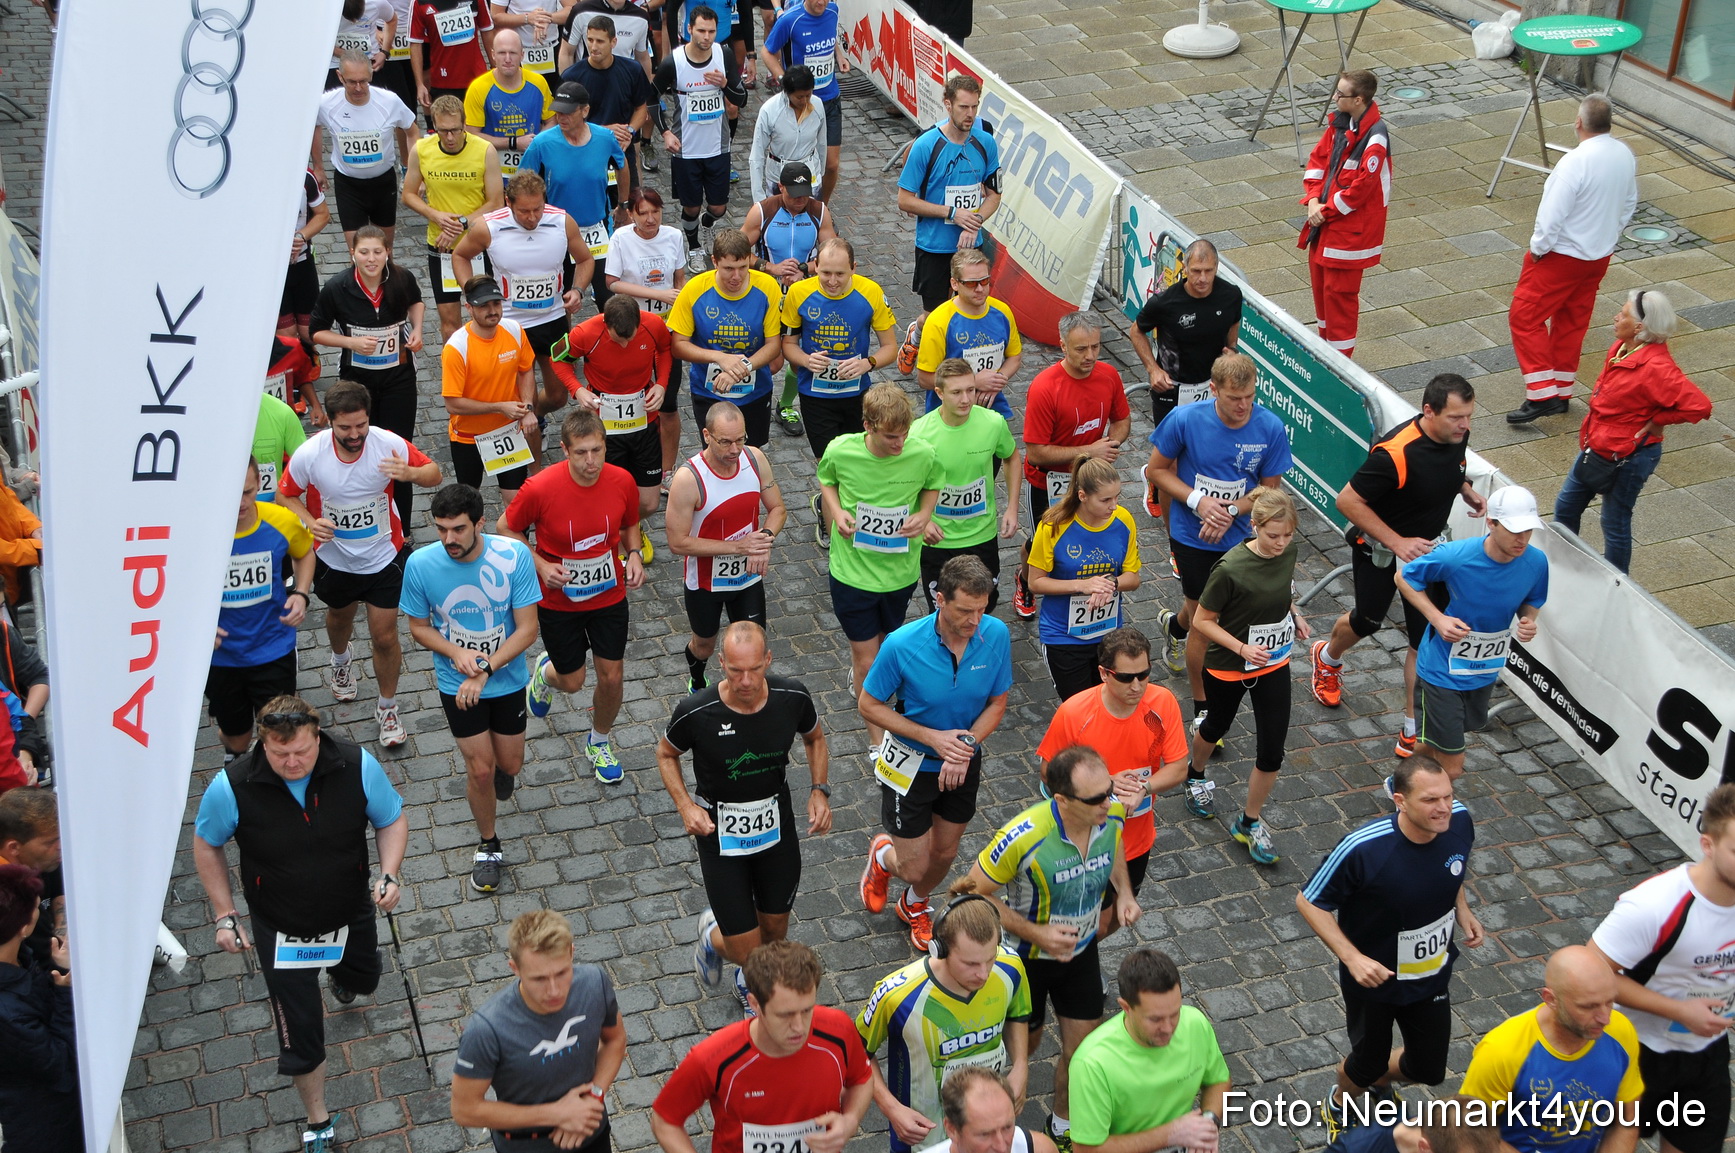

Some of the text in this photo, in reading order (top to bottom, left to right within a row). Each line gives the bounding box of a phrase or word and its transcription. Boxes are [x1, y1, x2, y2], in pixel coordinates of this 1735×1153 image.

[441, 16, 472, 34] 2243
[338, 39, 369, 52] 2823
[450, 33, 469, 41] Thomas
[805, 37, 836, 53] SYSCAD
[528, 49, 549, 63] 639
[809, 60, 833, 77] 2681
[691, 96, 720, 112] 2080
[343, 139, 379, 155] 2946
[504, 152, 523, 166] 26
[954, 194, 977, 209] 652
[516, 282, 553, 299] 2525
[1241, 316, 1313, 384] Event-Leit-Systeme
[977, 355, 994, 372] 36
[132, 281, 205, 482] BKK
[615, 403, 635, 418] 14
[493, 436, 515, 456] 50
[502, 456, 516, 465] Tim
[941, 488, 982, 507] 2708
[1308, 484, 1329, 509] 6352
[329, 509, 374, 529] 3425
[950, 508, 973, 516] Daniel
[861, 514, 904, 536] 2234
[874, 538, 888, 547] Tim
[231, 558, 261, 567] Neumarkt
[568, 562, 612, 586] 2340
[222, 589, 262, 602] Alexander
[576, 585, 605, 596] Manfred
[451, 605, 480, 615] anders
[1075, 599, 1115, 625] 2157
[112, 525, 171, 748] Audi
[1081, 622, 1106, 634] Ramona
[1254, 625, 1293, 651] 2040
[1457, 640, 1506, 659] 2120
[1531, 672, 1550, 693] die
[1550, 686, 1601, 743] verbinden
[876, 761, 893, 778] Peter
[725, 808, 775, 835] 2343
[740, 837, 762, 848] Peter
[990, 818, 1035, 865] BOCK
[1053, 851, 1112, 885] BOCK
[1054, 854, 1080, 868] TEAM
[1444, 853, 1465, 868] adidas
[1400, 933, 1423, 942] PARTL
[1414, 927, 1448, 960] 604
[296, 950, 325, 960] Robert
[863, 971, 908, 1028] BOCK
[939, 1021, 1003, 1057] BOCK
[744, 1125, 813, 1139] PARTL Neumarkt
